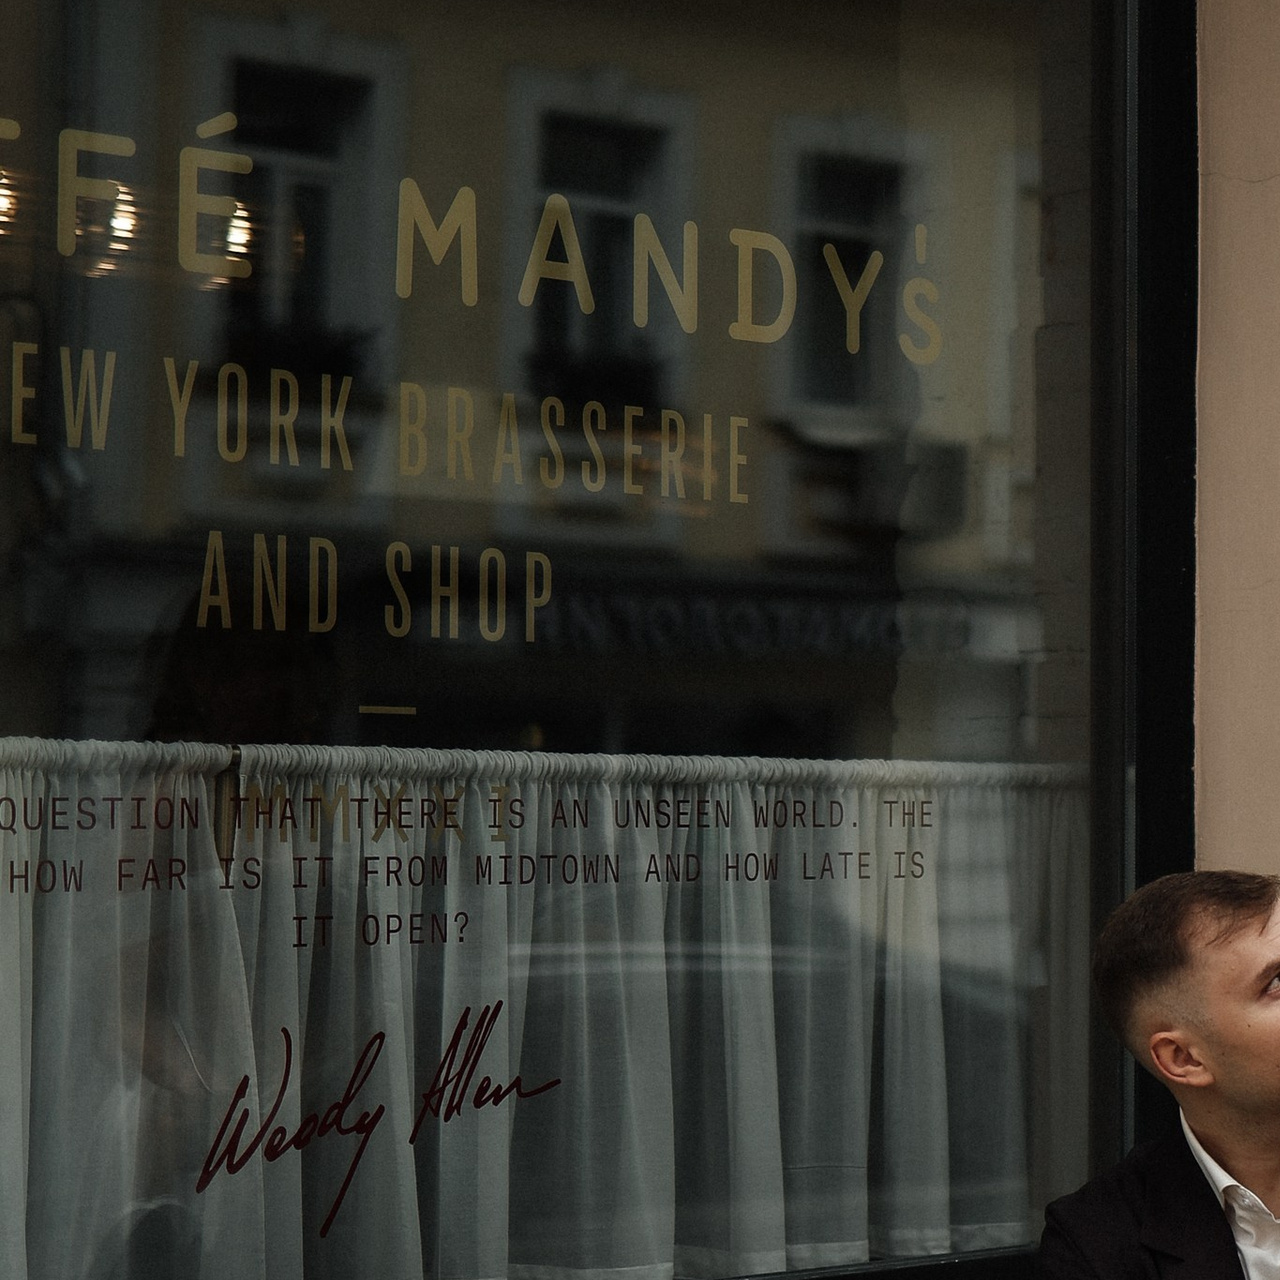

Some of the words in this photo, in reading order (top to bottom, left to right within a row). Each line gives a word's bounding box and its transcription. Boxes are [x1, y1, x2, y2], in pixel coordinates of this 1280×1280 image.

[0, 111, 254, 279] FÉ
[11, 341, 117, 451] EW
[163, 356, 354, 471] YORK
[399, 381, 750, 504] BRASSERIE
[196, 530, 338, 633] AND
[384, 541, 552, 643] SHOP
[0, 796, 200, 835] QUESTION
[230, 796, 323, 830] THAT
[350, 797, 461, 830] THERE
[487, 798, 526, 830] IS
[551, 798, 590, 829] AN
[614, 798, 731, 829] UNSEEN
[752, 799, 859, 829] WORLD.
[883, 800, 934, 828] THE
[8, 859, 84, 894] HOW
[117, 857, 188, 892] FAR
[218, 856, 262, 890] IS
[292, 856, 335, 889] IT
[363, 855, 449, 888] FROM
[475, 854, 620, 886] MIDTOWN
[644, 853, 701, 883] AND
[725, 852, 780, 883] HOW
[802, 851, 872, 881] LATE
[893, 850, 926, 880] IS
[292, 915, 335, 949] IT
[361, 910, 470, 947] OPEN?
[408, 999, 562, 1145] Allen
